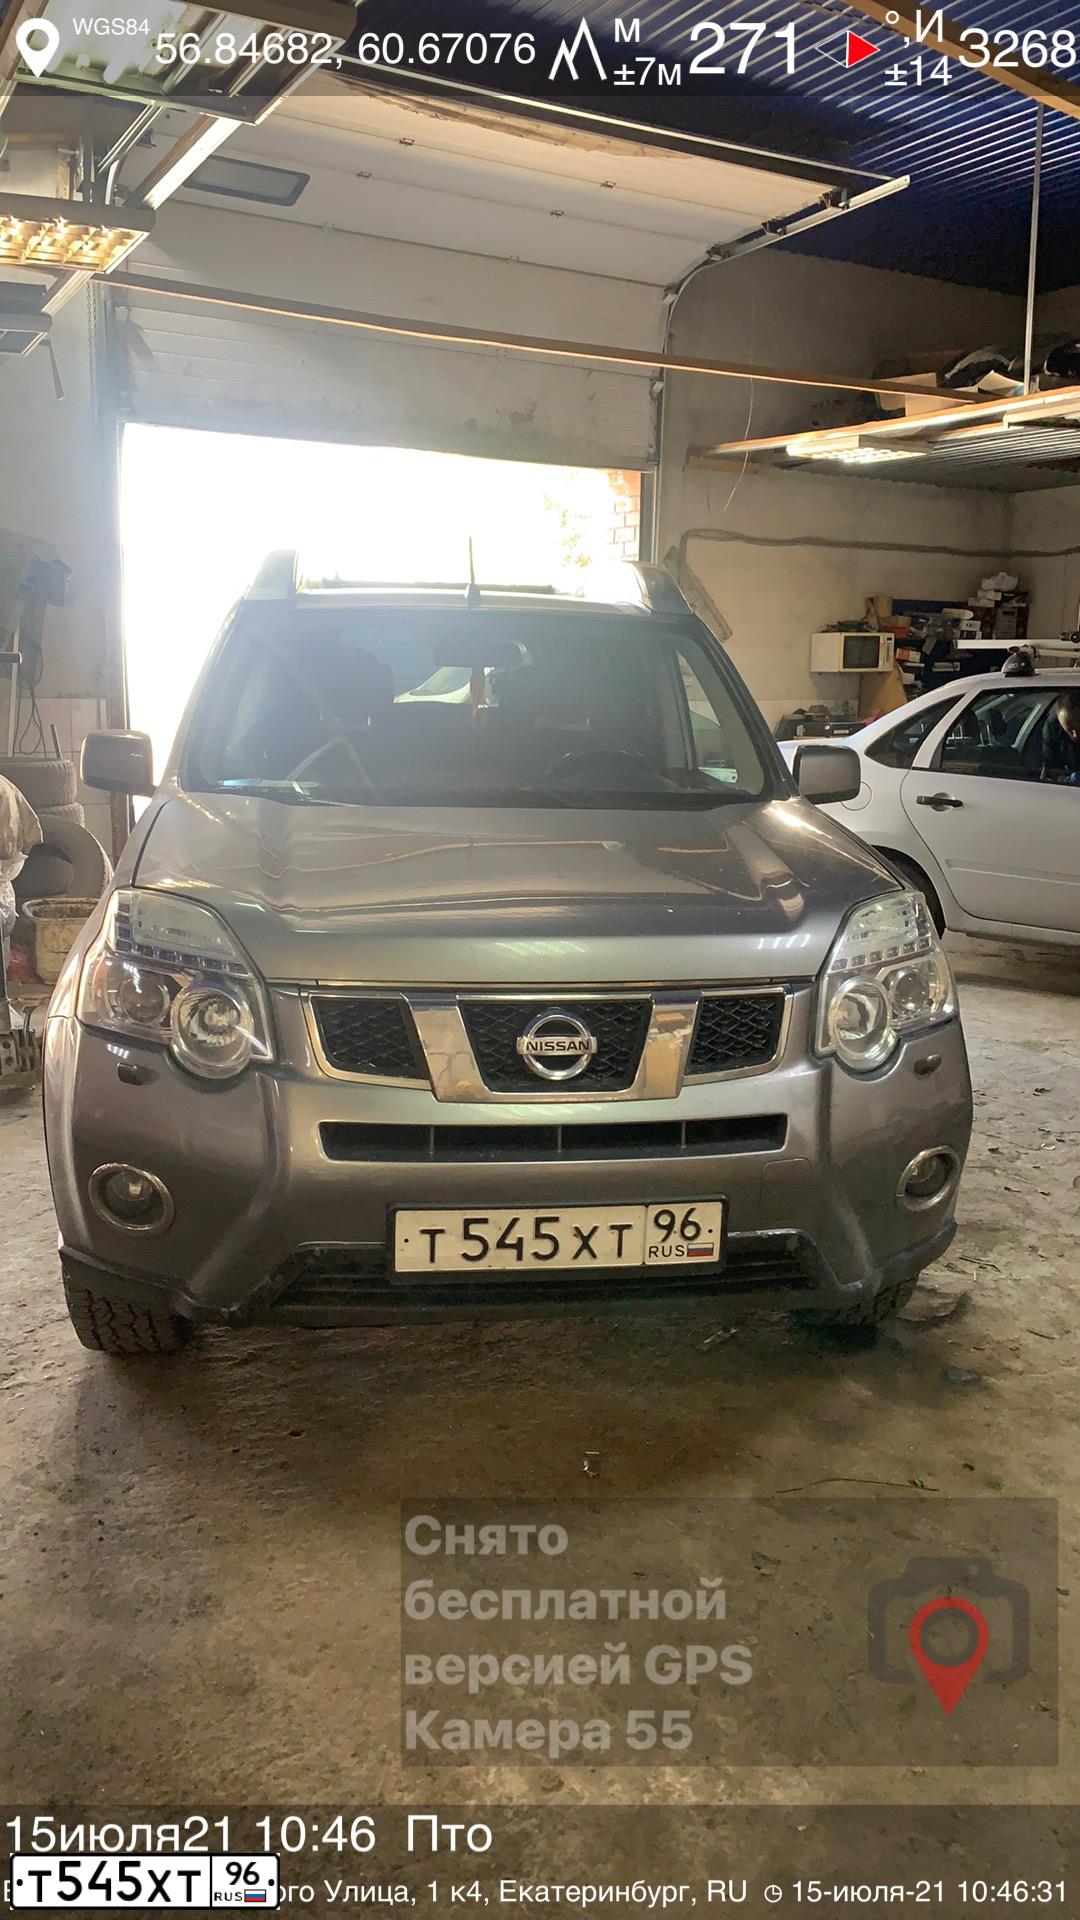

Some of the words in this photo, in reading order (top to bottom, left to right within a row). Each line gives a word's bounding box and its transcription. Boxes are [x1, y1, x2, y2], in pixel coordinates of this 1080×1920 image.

[526, 1041, 590, 1051] NISSAN
[653, 1207, 701, 1242] 96
[648, 1245, 685, 1258] RUS
